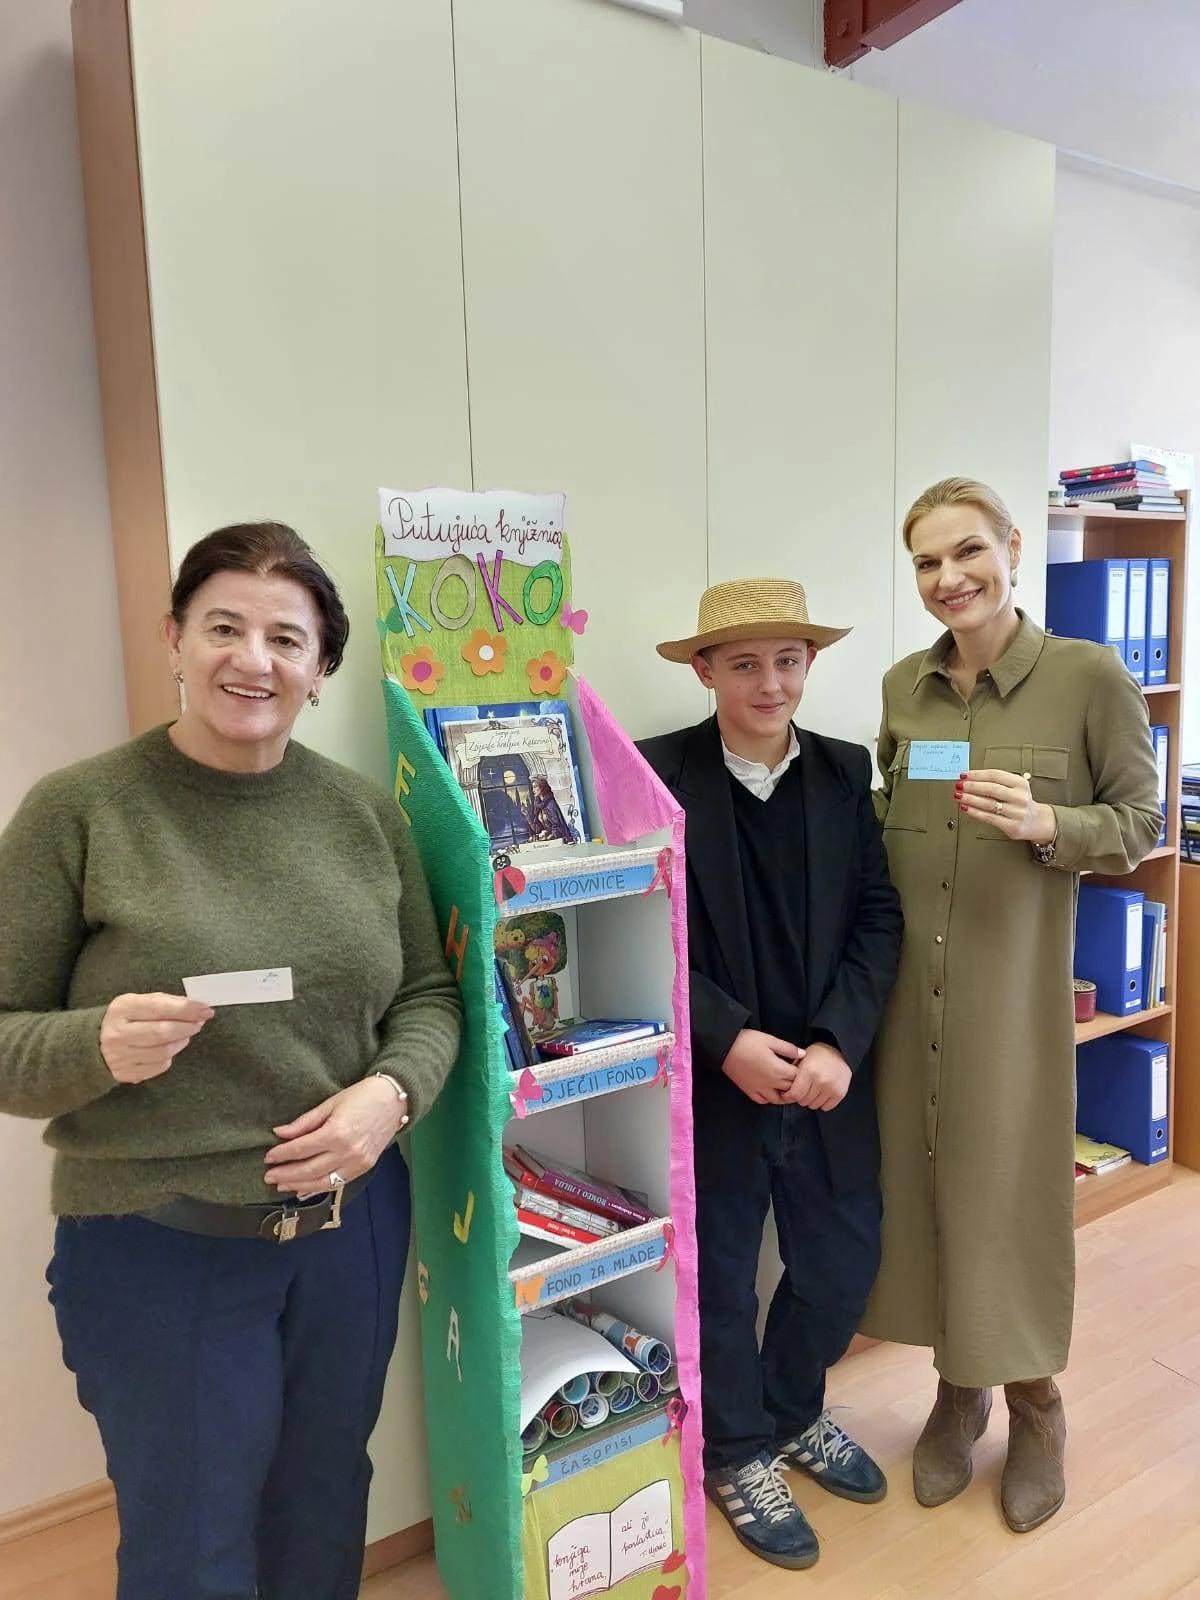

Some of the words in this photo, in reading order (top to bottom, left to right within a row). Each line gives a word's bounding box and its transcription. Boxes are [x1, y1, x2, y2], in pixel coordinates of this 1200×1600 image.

[388, 497, 493, 553] Putujuća
[384, 549, 564, 638] KOKO
[528, 874, 625, 903] SLIKOVNICE
[606, 1066, 647, 1086] FOND
[583, 1191, 608, 1206] ROMEO
[547, 1273, 582, 1296] FOND
[591, 1265, 605, 1280] ZA
[613, 1246, 656, 1271] MLADE
[561, 1436, 633, 1475] ČASOPISI
